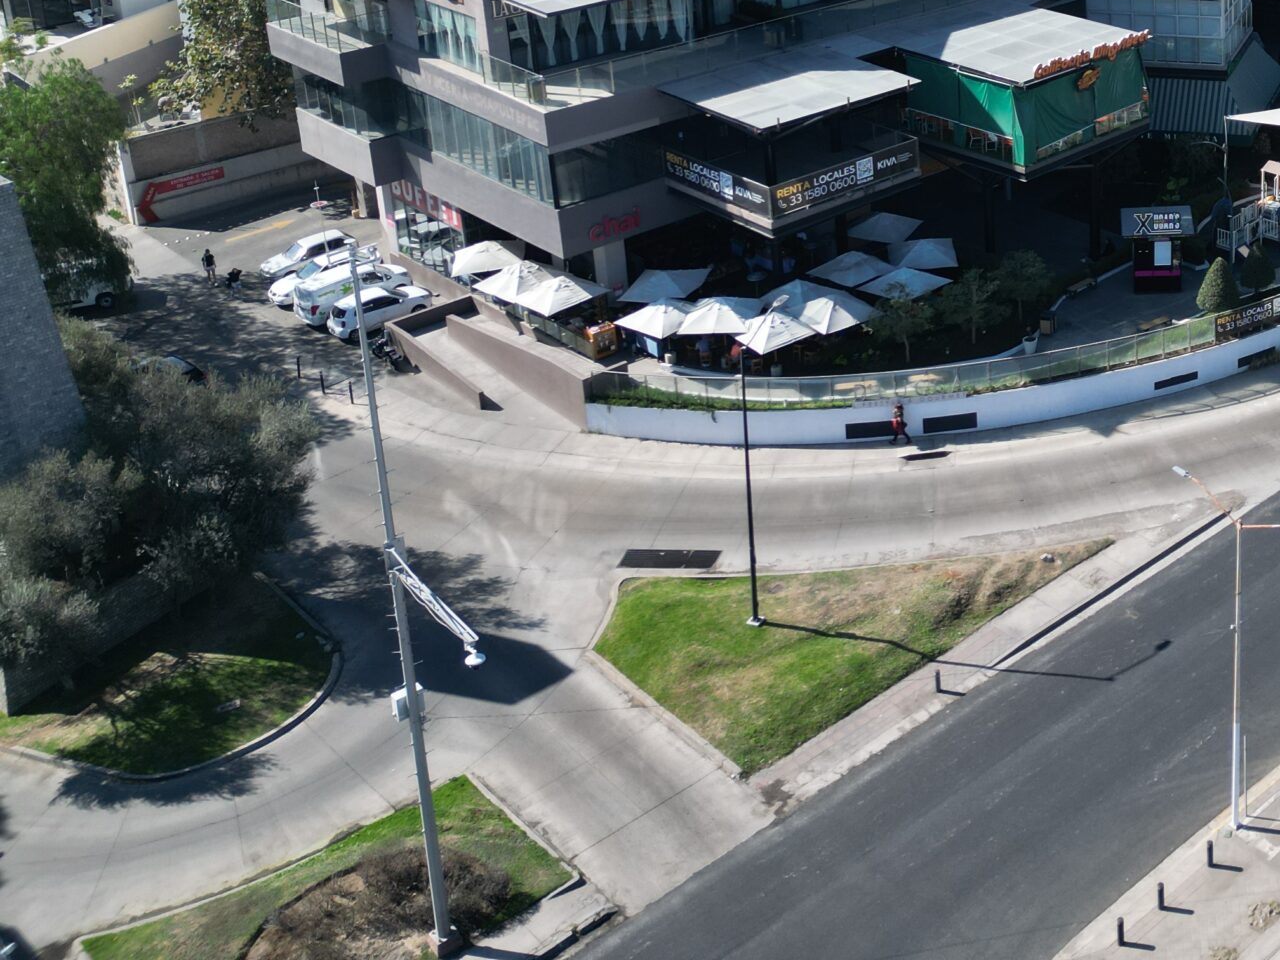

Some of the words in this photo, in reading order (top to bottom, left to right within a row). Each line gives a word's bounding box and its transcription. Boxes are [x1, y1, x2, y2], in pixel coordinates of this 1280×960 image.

[1033, 50, 1090, 79] California
[666, 152, 688, 169] RENTA
[689, 161, 720, 181] LOCALES
[877, 156, 898, 170] KIVA
[675, 165, 683, 177] 33
[684, 168, 700, 184] 1580
[700, 176, 720, 193] 0600
[735, 186, 752, 200] KIVA
[776, 181, 811, 199] RENTA
[813, 165, 856, 186] LOCALES
[790, 193, 803, 206] 33
[804, 185, 828, 200] 1580
[829, 174, 856, 192] 0600
[391, 180, 461, 227] BUFFET
[590, 206, 641, 244] chai
[1217, 313, 1240, 325] RENTA
[1243, 302, 1272, 317] LOCALES
[1225, 322, 1234, 331] 33
[1237, 316, 1252, 327] 1580
[1253, 309, 1272, 322] 0600
